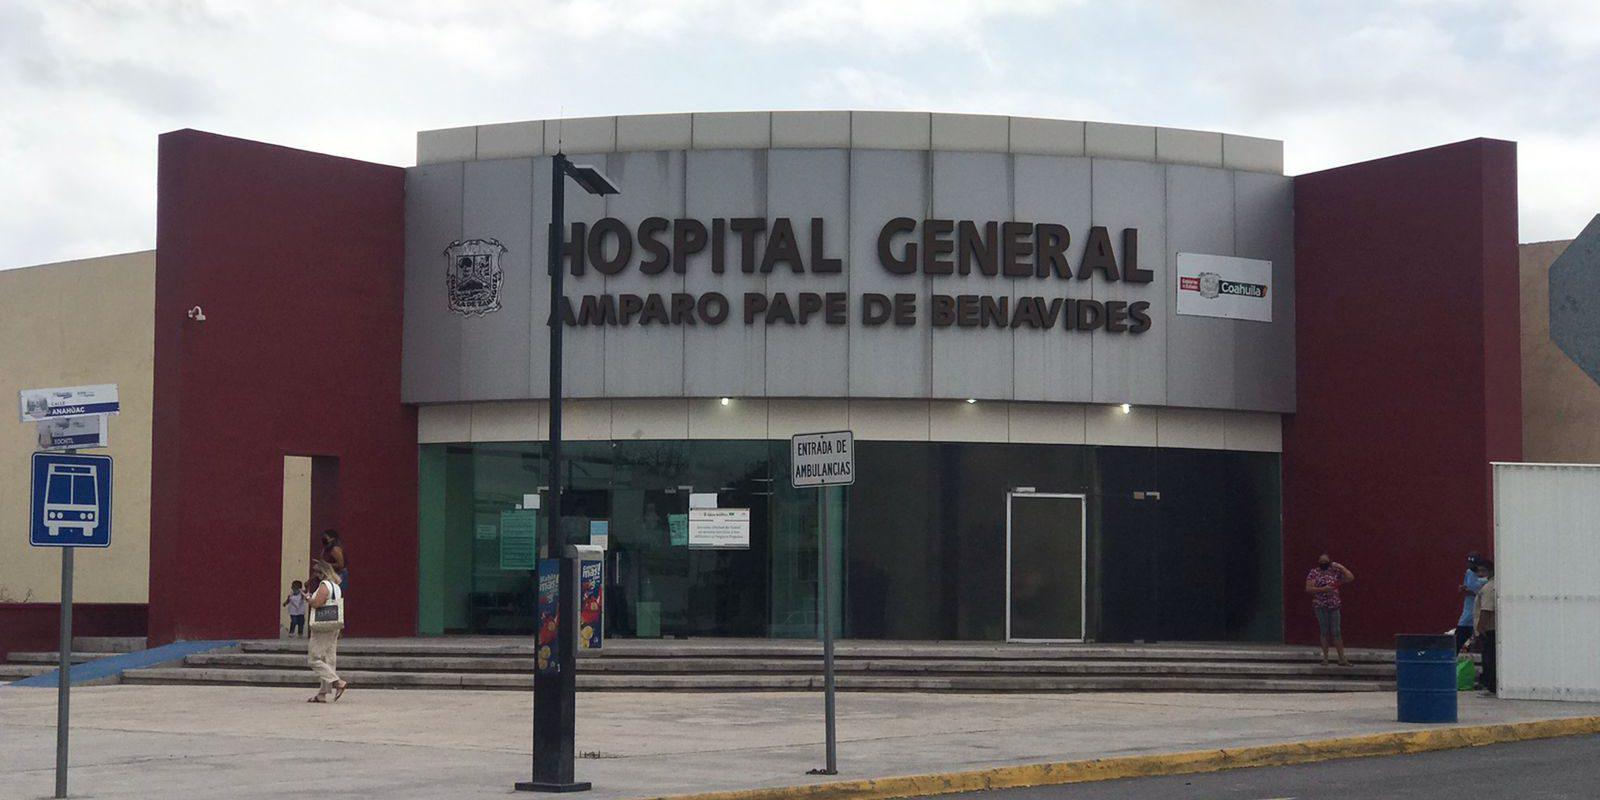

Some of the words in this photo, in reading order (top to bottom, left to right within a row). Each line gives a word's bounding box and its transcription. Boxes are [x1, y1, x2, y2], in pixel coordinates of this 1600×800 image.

[548, 217, 842, 276] HOSPITAL
[877, 217, 1154, 283] GENERAL
[1221, 282, 1261, 296] Coahuila
[547, 292, 730, 327] AMPARO
[744, 292, 847, 325] PAPE
[862, 293, 917, 326] DE
[931, 294, 1152, 334] BENAVIDES
[798, 441, 833, 456] ENTRADA
[836, 440, 847, 453] DE
[795, 461, 851, 478] AMBULANCIAS
